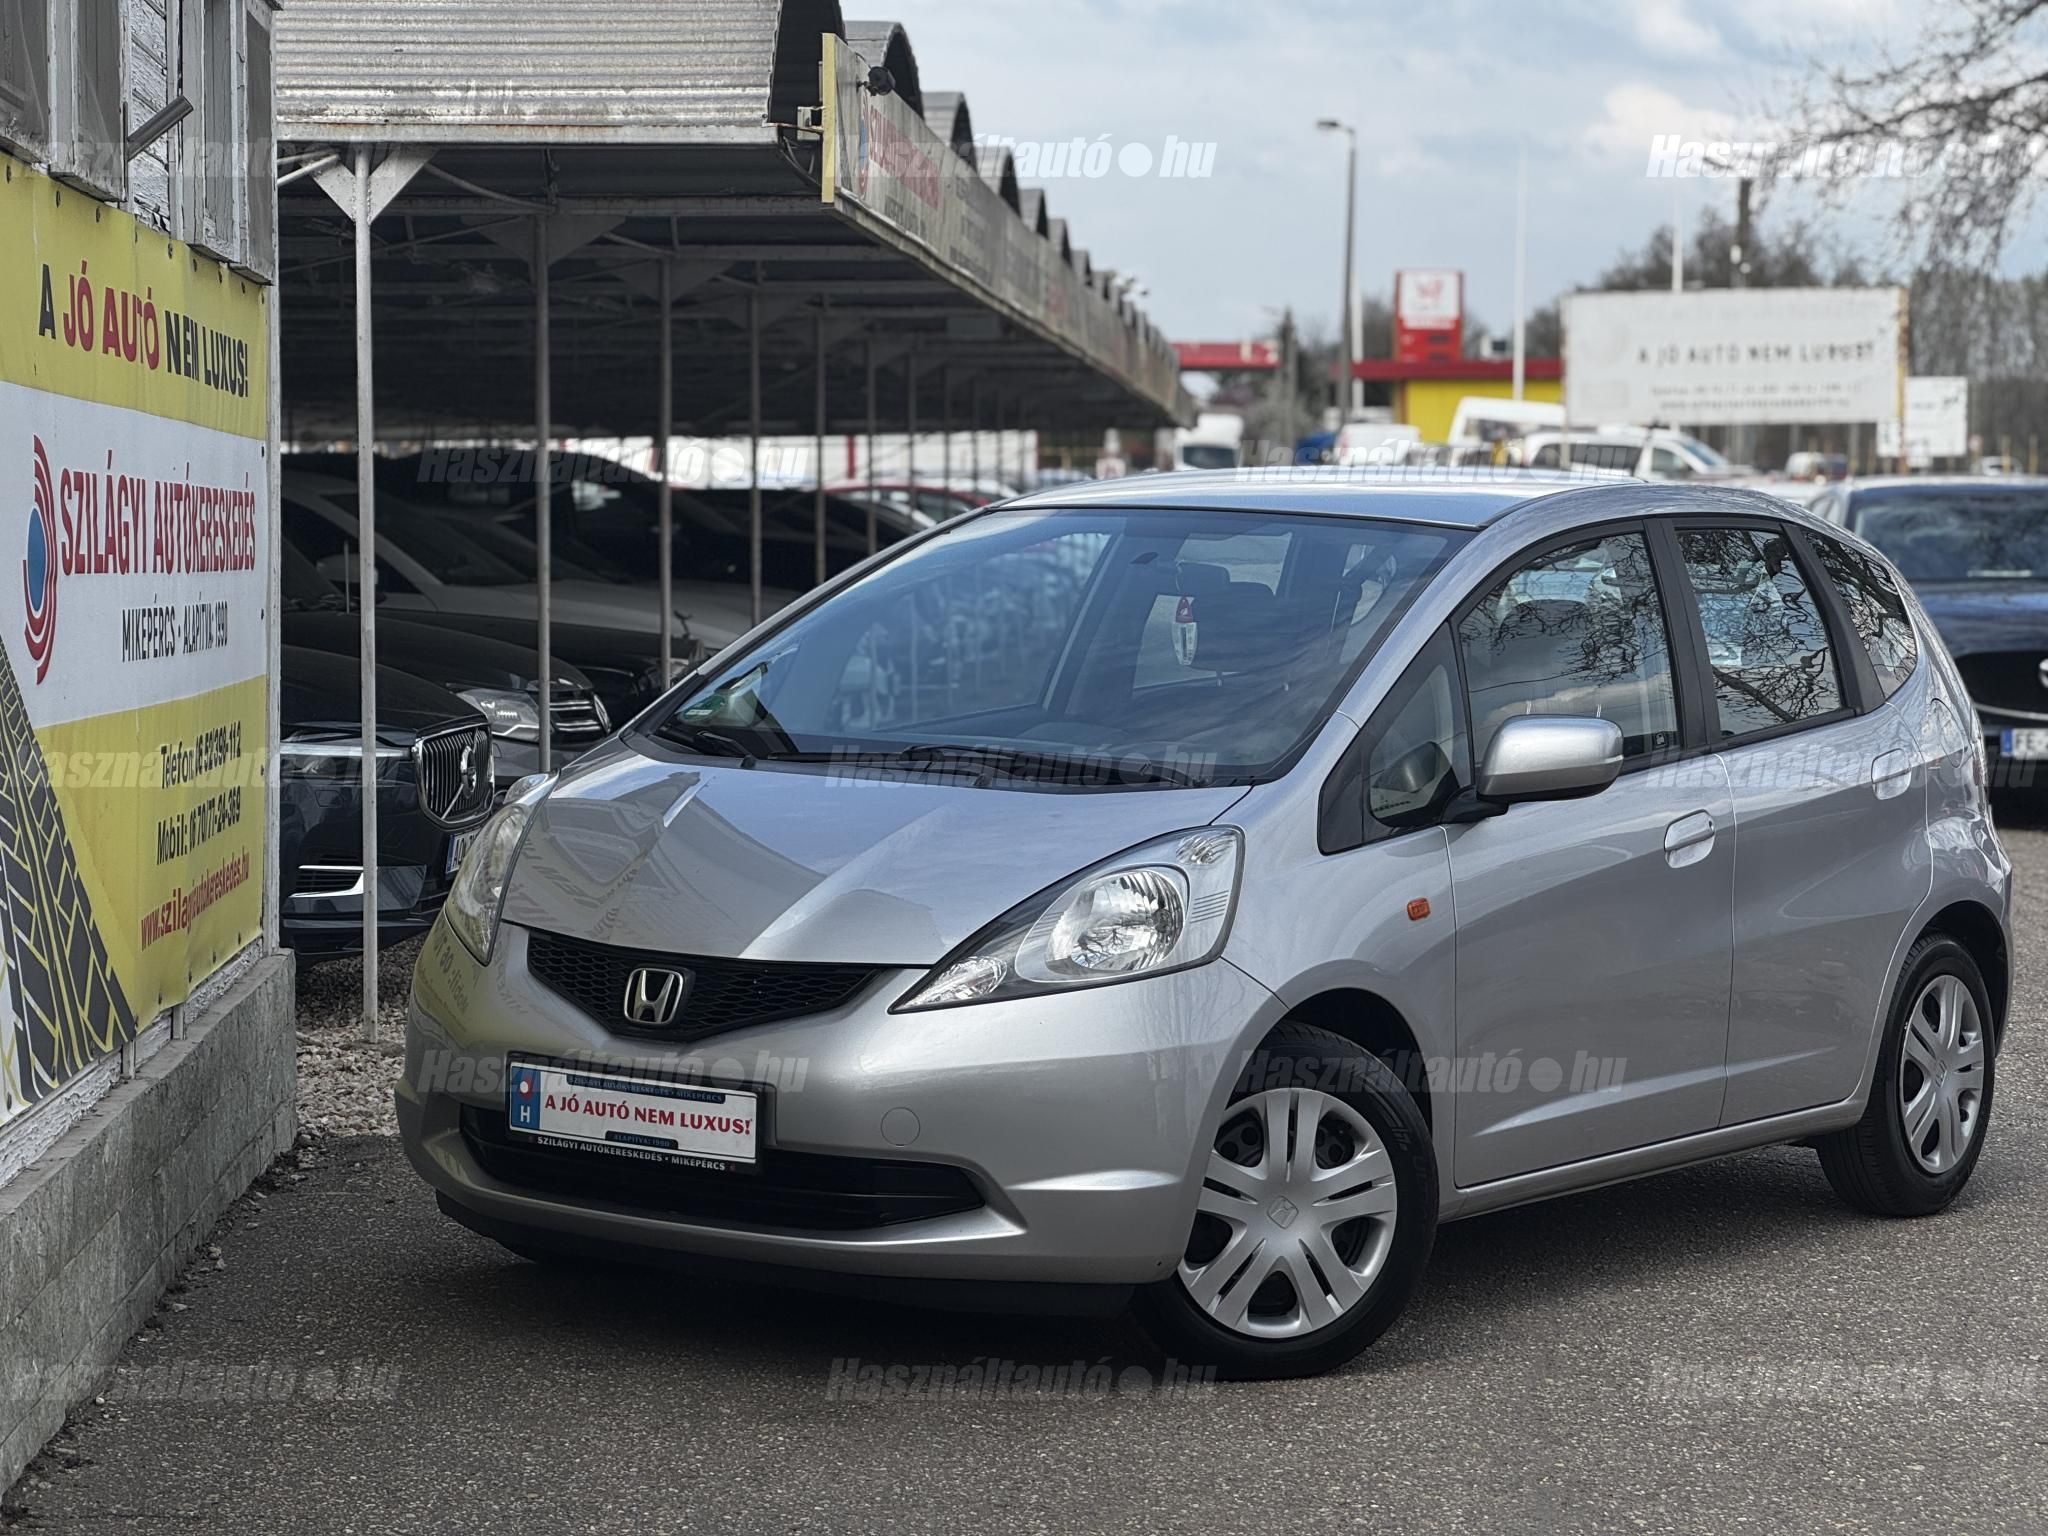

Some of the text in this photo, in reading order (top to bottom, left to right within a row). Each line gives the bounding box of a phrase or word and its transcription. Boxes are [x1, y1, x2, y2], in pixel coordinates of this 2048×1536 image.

[39, 260, 248, 398] A JÓ AUTÓ NEM LUXUS!
[61, 449, 255, 575] SZILÁGYI AUTÓKERESKEDÉS
[122, 593, 175, 662] MIKEPÉRCS
[157, 813, 187, 865] Mobil:
[520, 1104, 530, 1123] H
[545, 1093, 750, 1135] A JÓ AUTÓ NEM LUXUS!
[671, 1155, 726, 1171] MIKEPÉRCS
